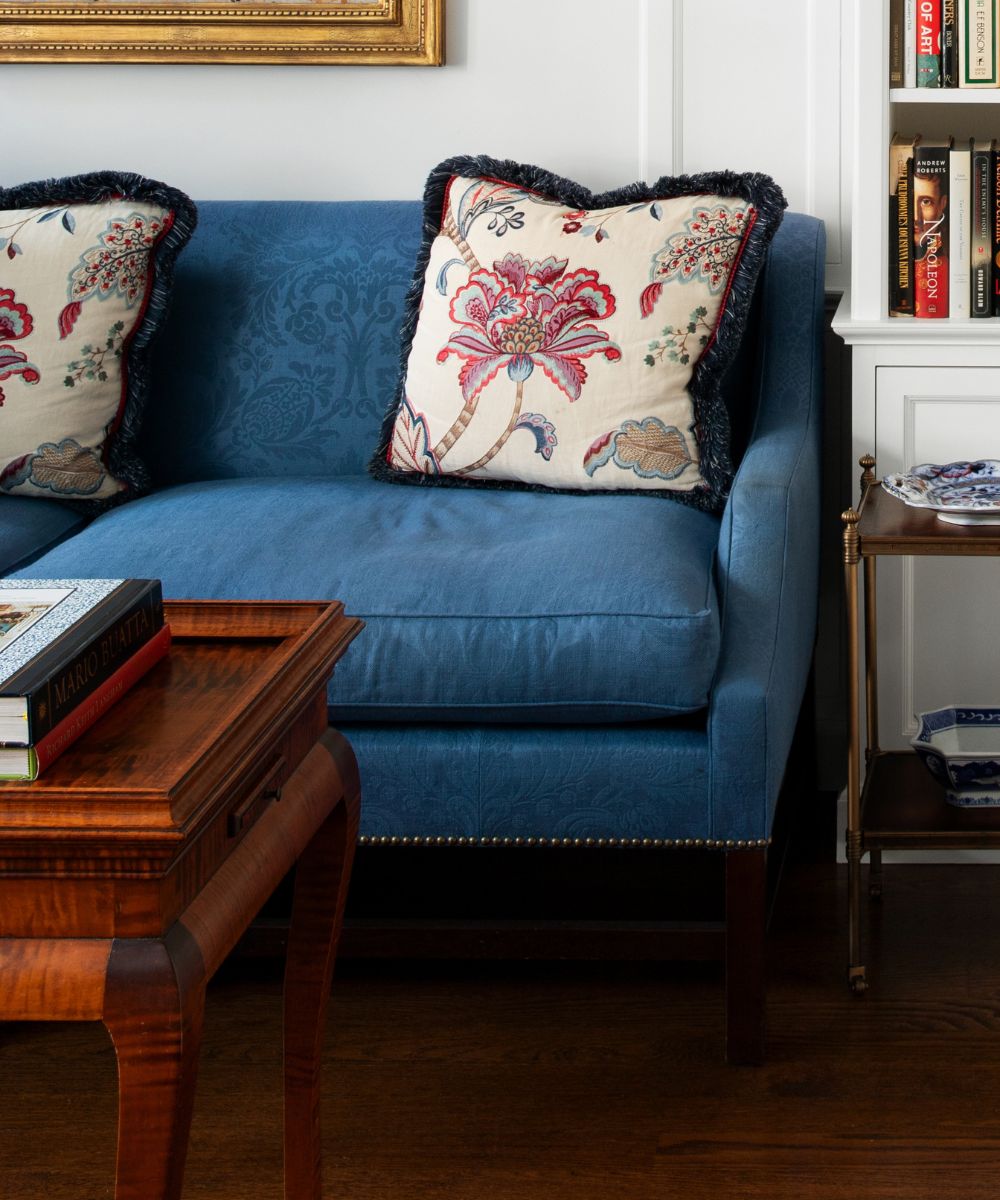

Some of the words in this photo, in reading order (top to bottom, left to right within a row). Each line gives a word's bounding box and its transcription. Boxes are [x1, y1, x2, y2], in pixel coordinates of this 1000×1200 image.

[921, 2, 933, 21] OF
[921, 25, 933, 56] ART
[976, 23, 984, 54] BENSON
[981, 163, 988, 171] IN
[898, 227, 908, 260] LOUISIANA
[919, 213, 945, 299] NAPOLEON
[899, 261, 908, 289] KITCHEN
[54, 651, 98, 710] MARIO
[102, 608, 149, 667] BUATTA
